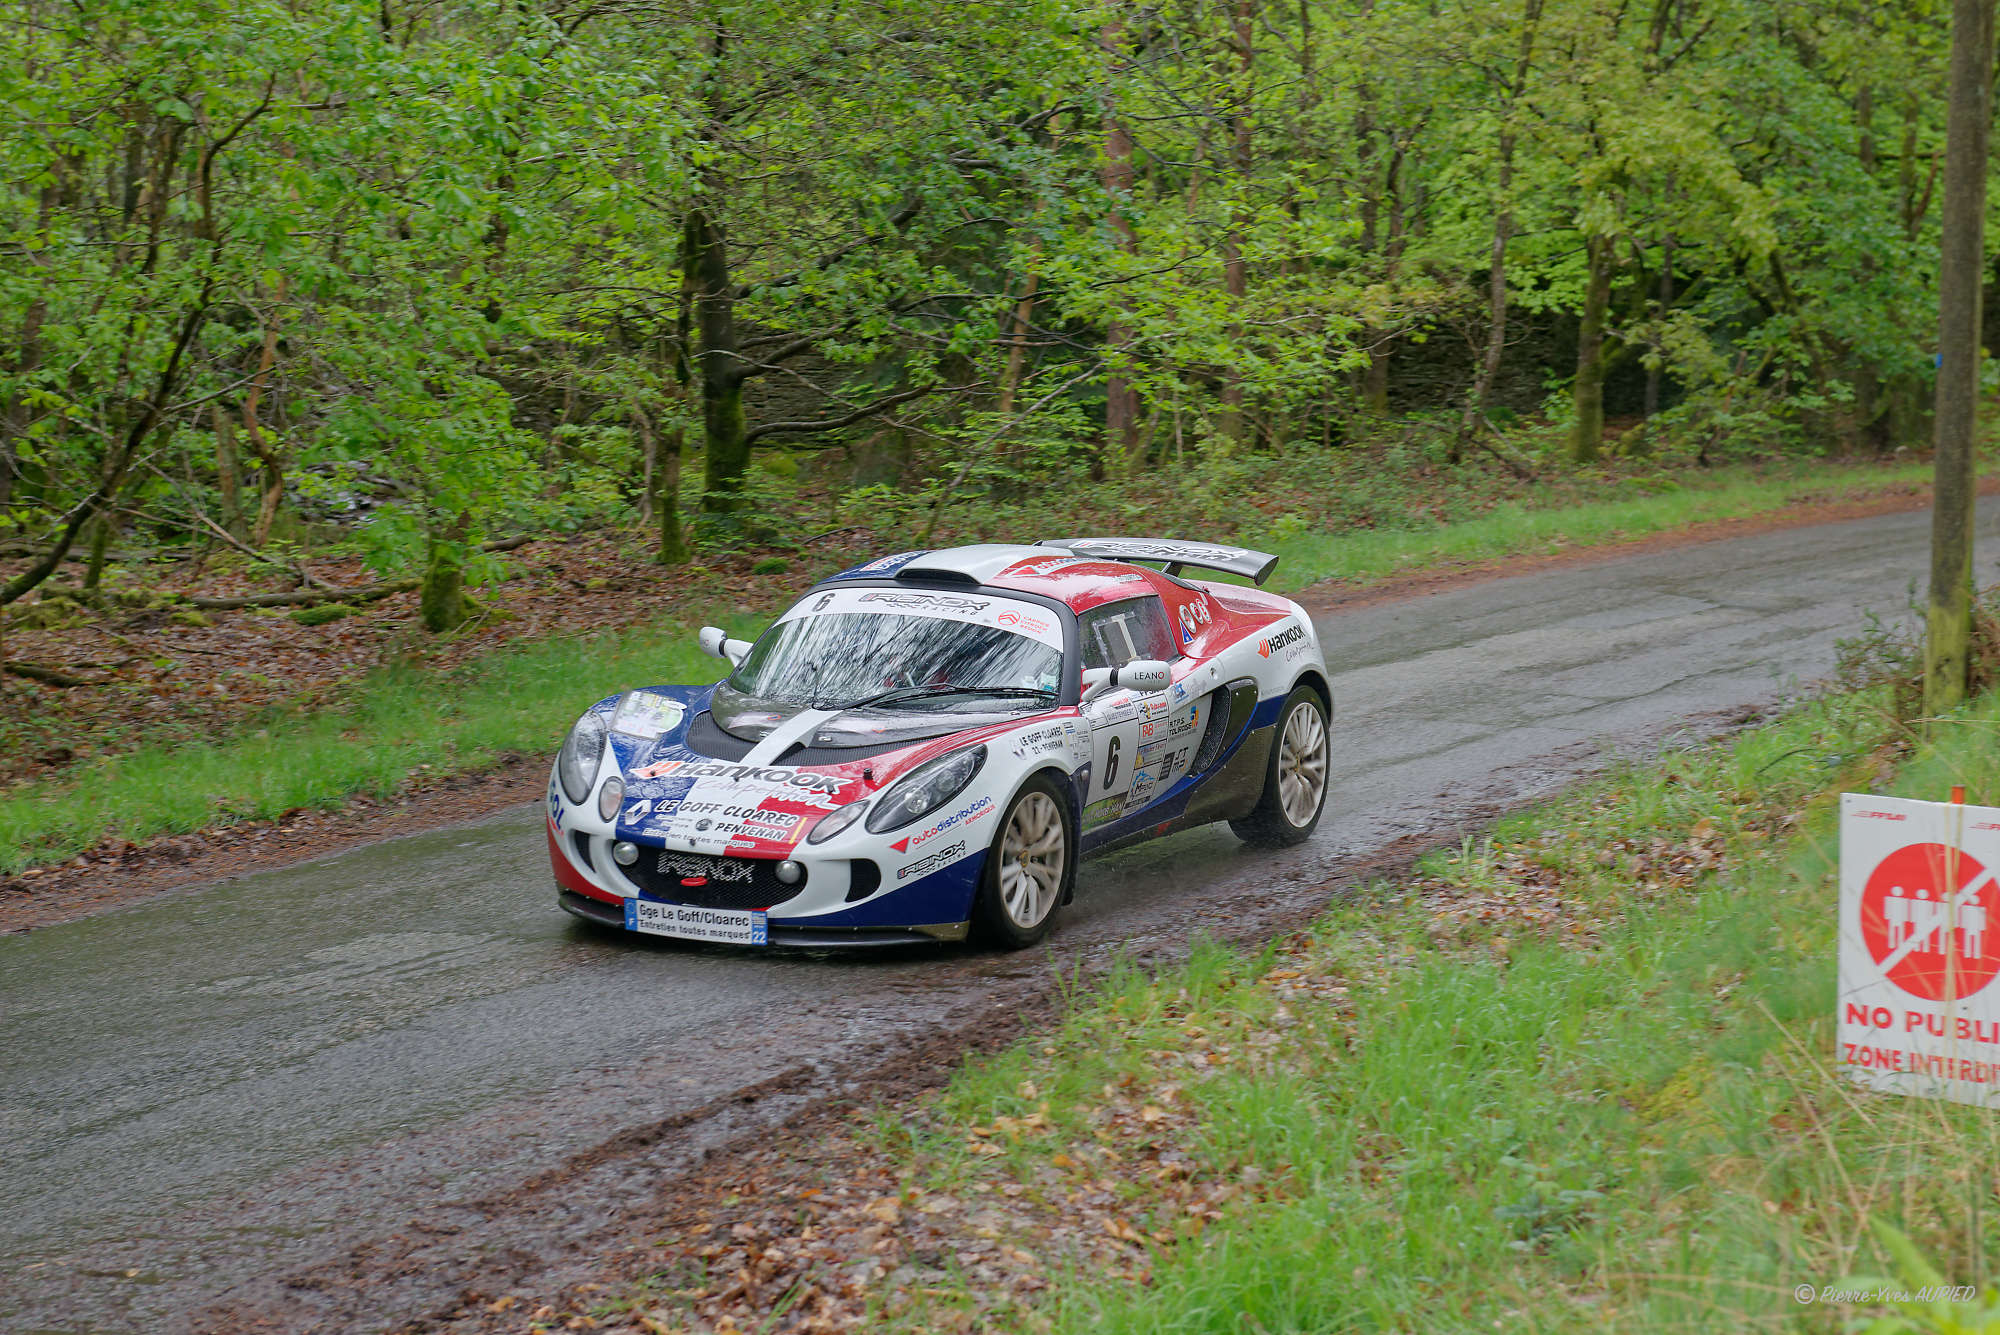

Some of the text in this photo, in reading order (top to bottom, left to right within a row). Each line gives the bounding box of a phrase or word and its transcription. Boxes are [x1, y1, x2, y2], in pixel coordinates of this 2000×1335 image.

[812, 592, 836, 612] 6
[921, 605, 979, 616] RACING
[1134, 671, 1165, 680] LEANO
[1019, 736, 1029, 746] LE
[1028, 731, 1042, 744] GOFF
[1103, 735, 1120, 790] 6
[655, 799, 798, 827] LE GOFF CLOAREC
[912, 796, 992, 845] autodistribution
[714, 822, 787, 841] PENVENAN
[713, 838, 755, 849] marques
[639, 904, 659, 918] Gge
[661, 908, 674, 920] Le
[677, 910, 750, 927] Goff/Cloarec
[640, 919, 750, 940] Entretien toutes marques
[753, 931, 767, 944] 22
[1845, 1002, 1893, 1030] NO
[1843, 1042, 2000, 1085] ZONE INTERDI
